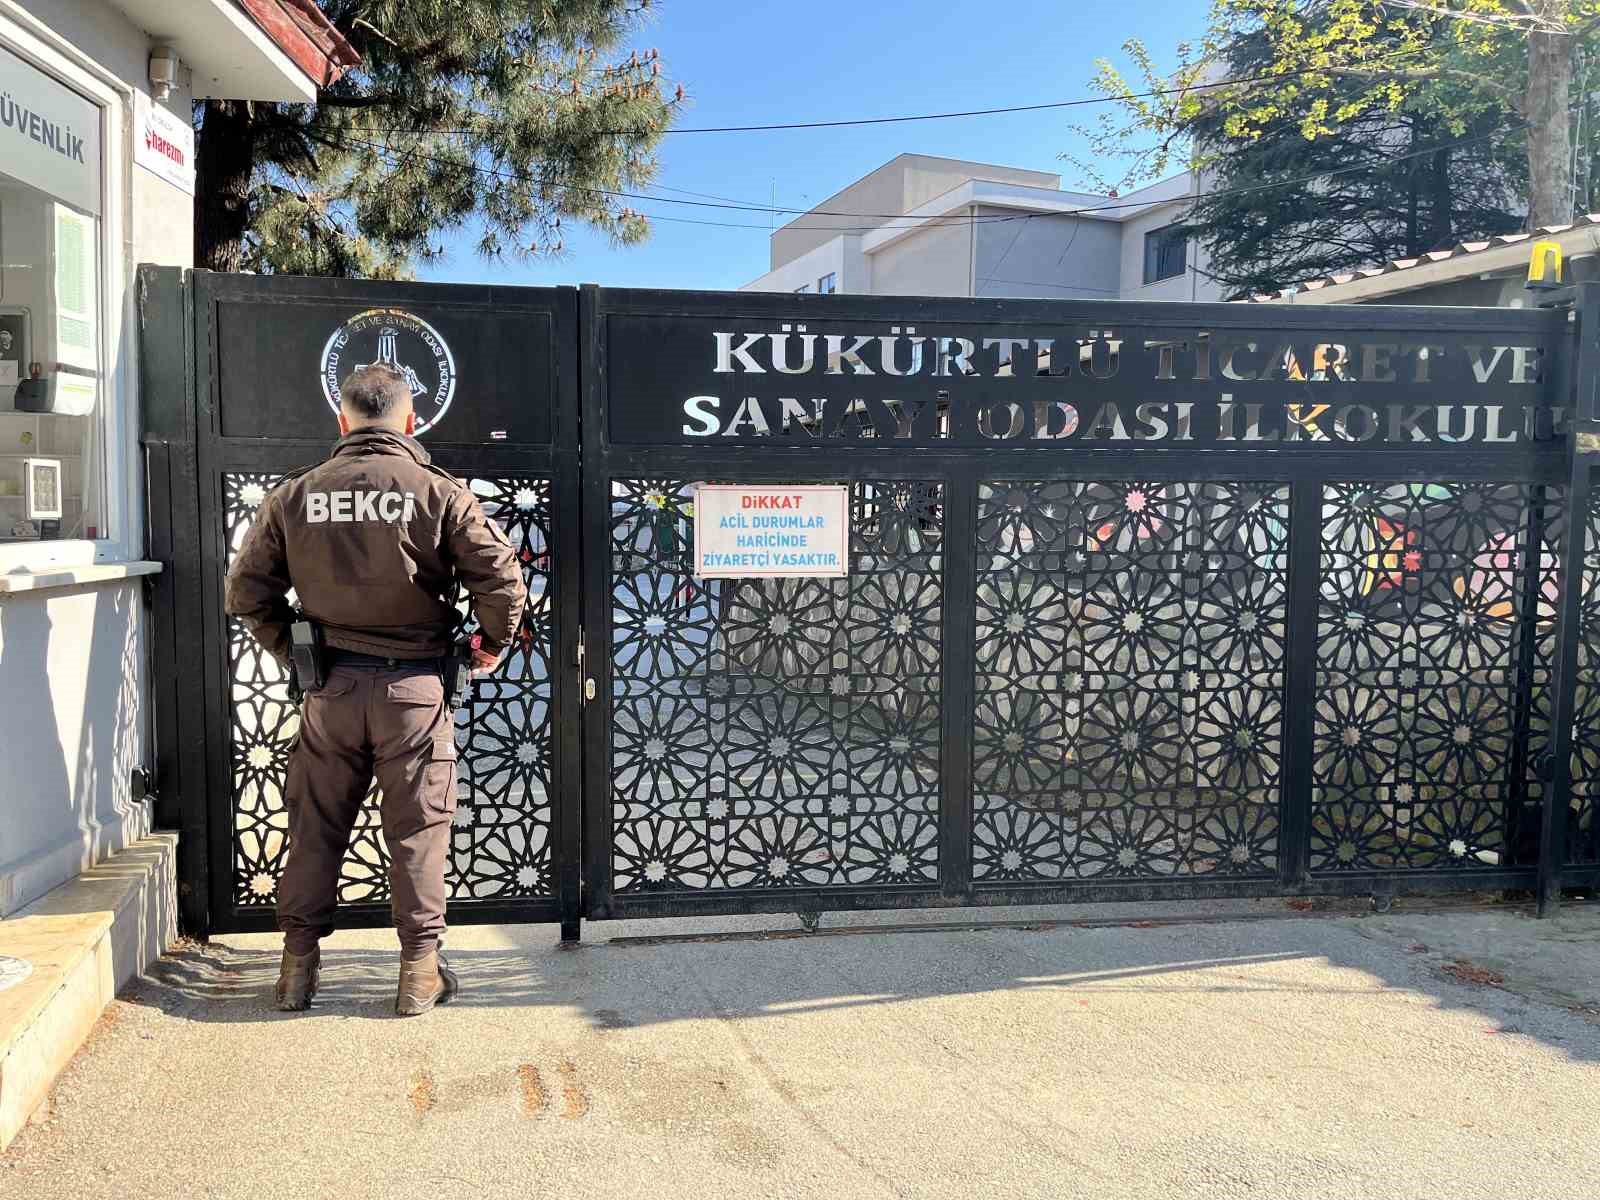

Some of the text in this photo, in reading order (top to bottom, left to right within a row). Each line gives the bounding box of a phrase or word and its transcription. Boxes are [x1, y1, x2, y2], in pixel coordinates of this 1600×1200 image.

[0, 91, 85, 165] ÜVENLİK
[712, 323, 1541, 384] KÜKÜRTLÜ TİCARET VE
[682, 390, 950, 440] SANAYİ
[976, 401, 1195, 441] ODASI
[719, 512, 825, 529] ACİL DURUMLAR
[736, 531, 808, 547] HARİCİNDE
[703, 551, 841, 567] ZİYARETÇİ YASAKTIR.
